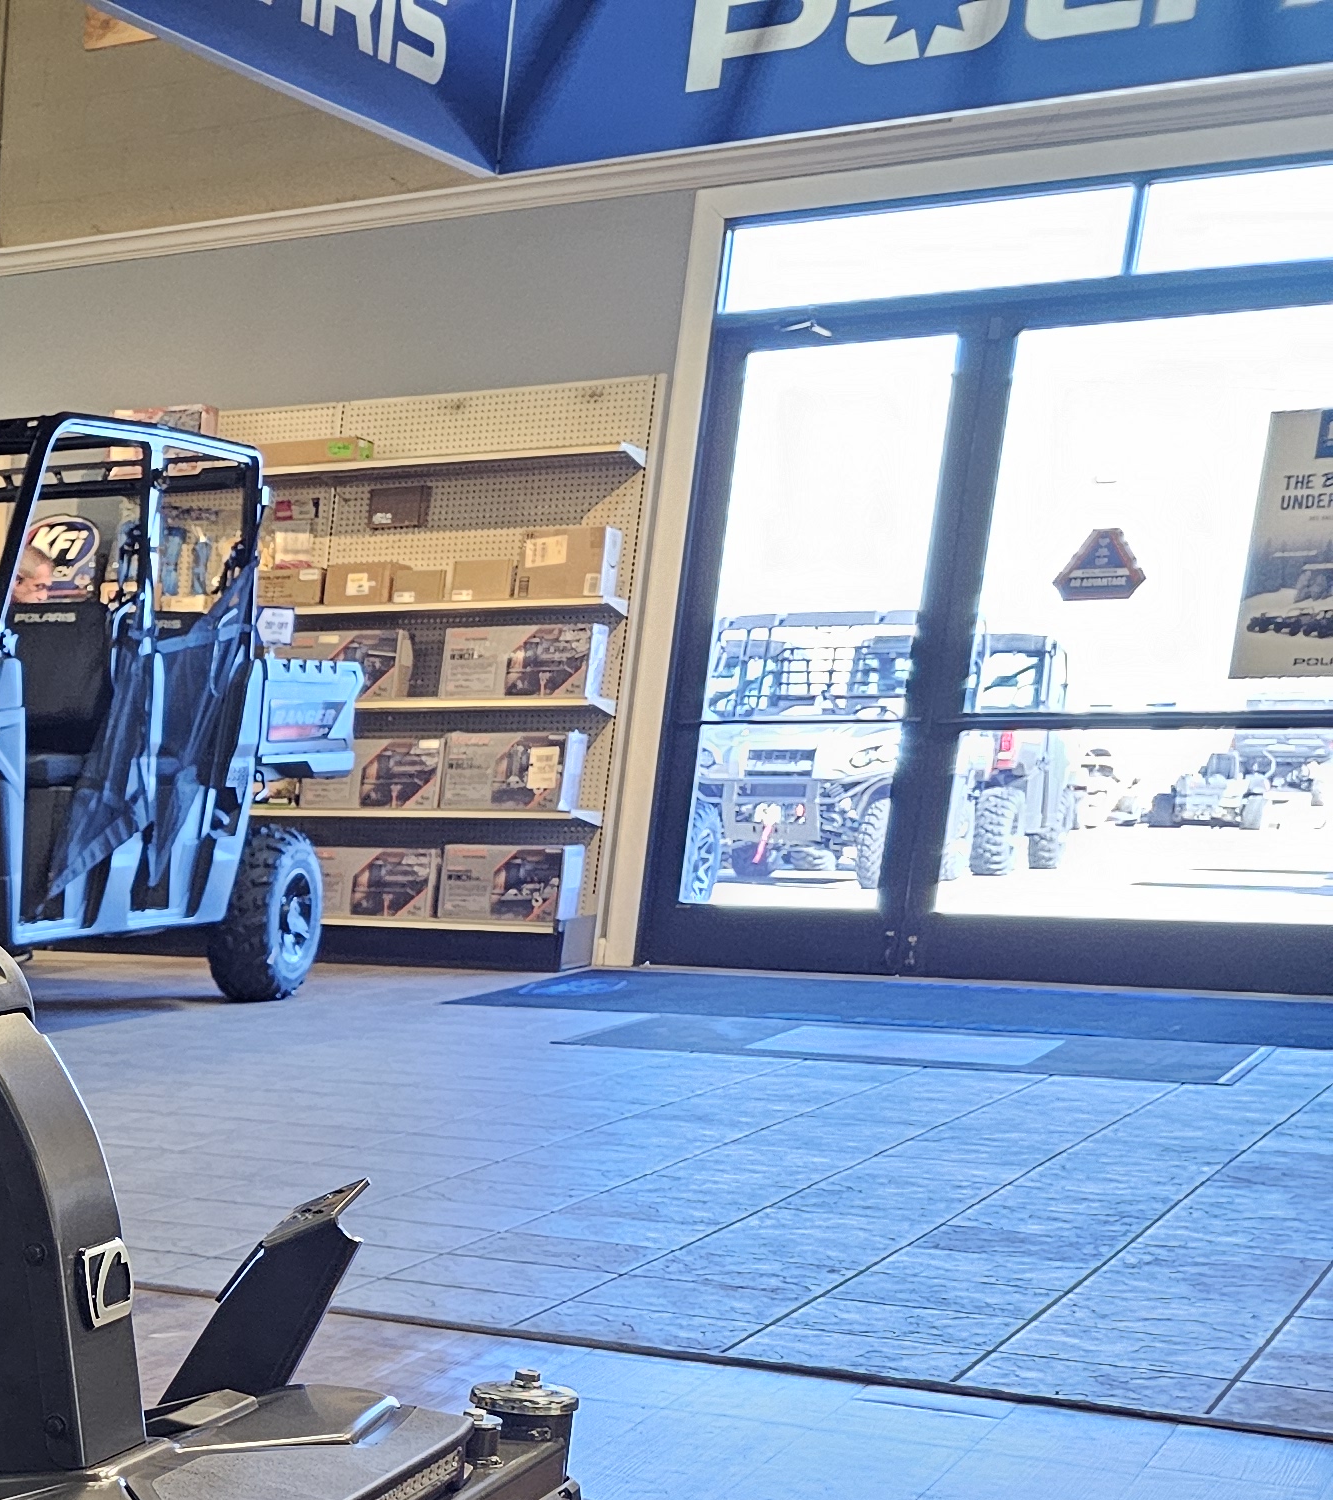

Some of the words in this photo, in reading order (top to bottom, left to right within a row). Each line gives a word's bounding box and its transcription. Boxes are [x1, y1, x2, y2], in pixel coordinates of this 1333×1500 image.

[1283, 473, 1317, 490] THE
[14, 612, 77, 624] POLARIS
[272, 708, 337, 728] RANGER
